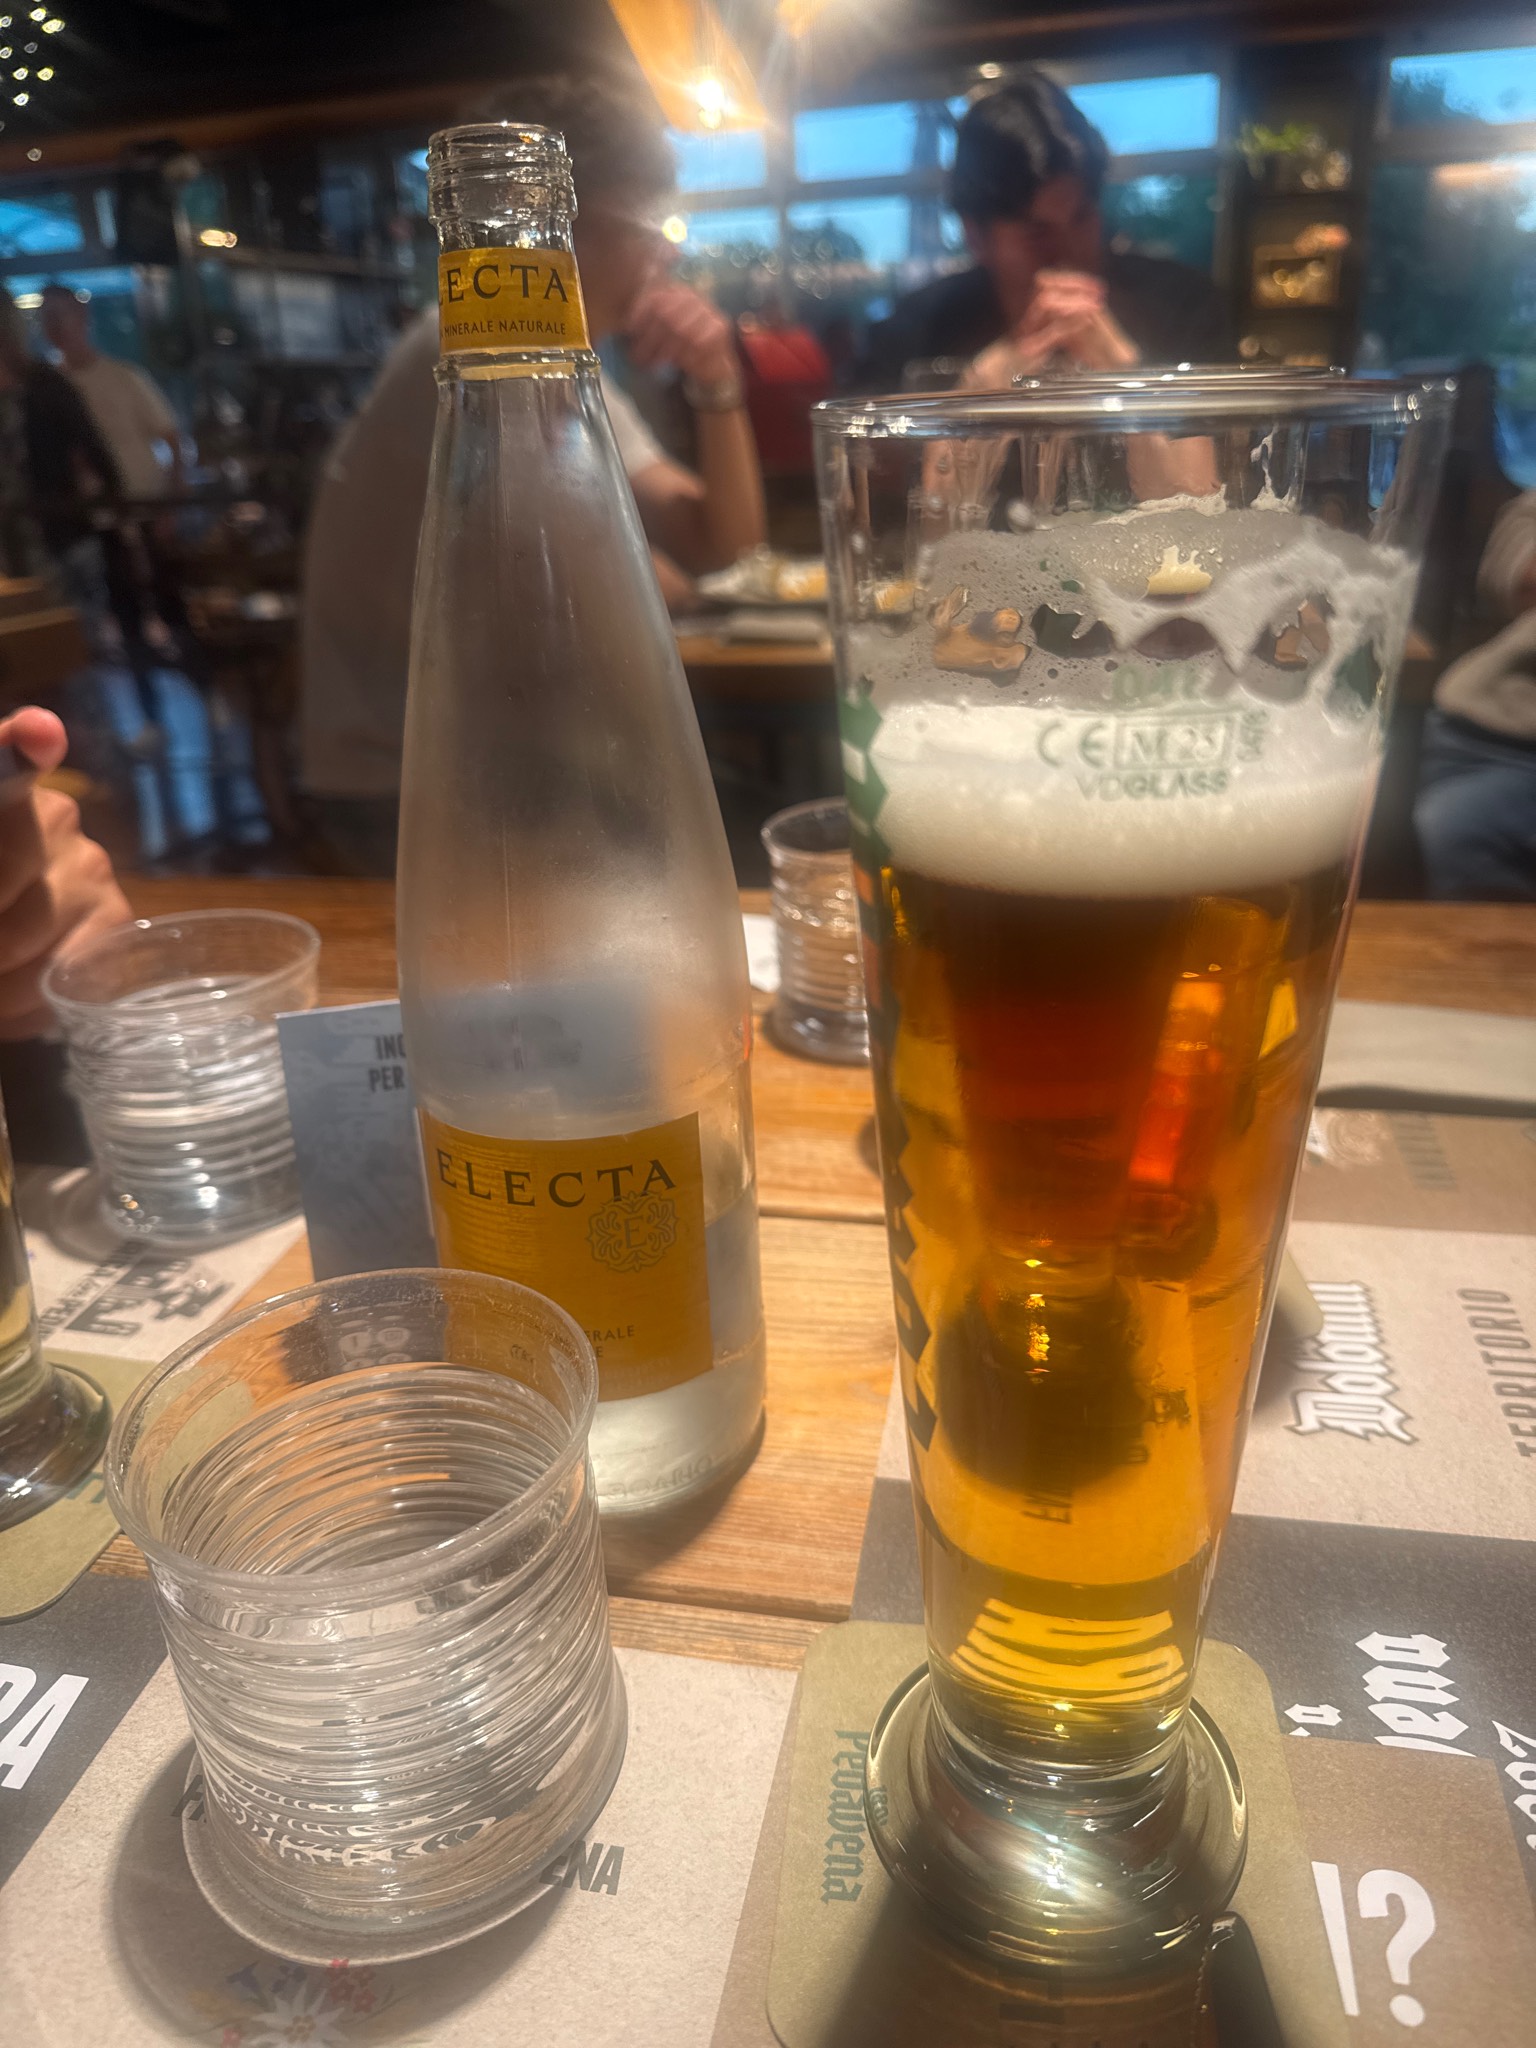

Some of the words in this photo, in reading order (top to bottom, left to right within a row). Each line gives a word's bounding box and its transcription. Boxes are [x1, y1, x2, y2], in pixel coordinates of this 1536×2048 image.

[440, 263, 570, 305] ECTA
[444, 319, 494, 338] MINERALE
[498, 319, 567, 336] NATURALE
[435, 1148, 677, 1209] ELECTA
